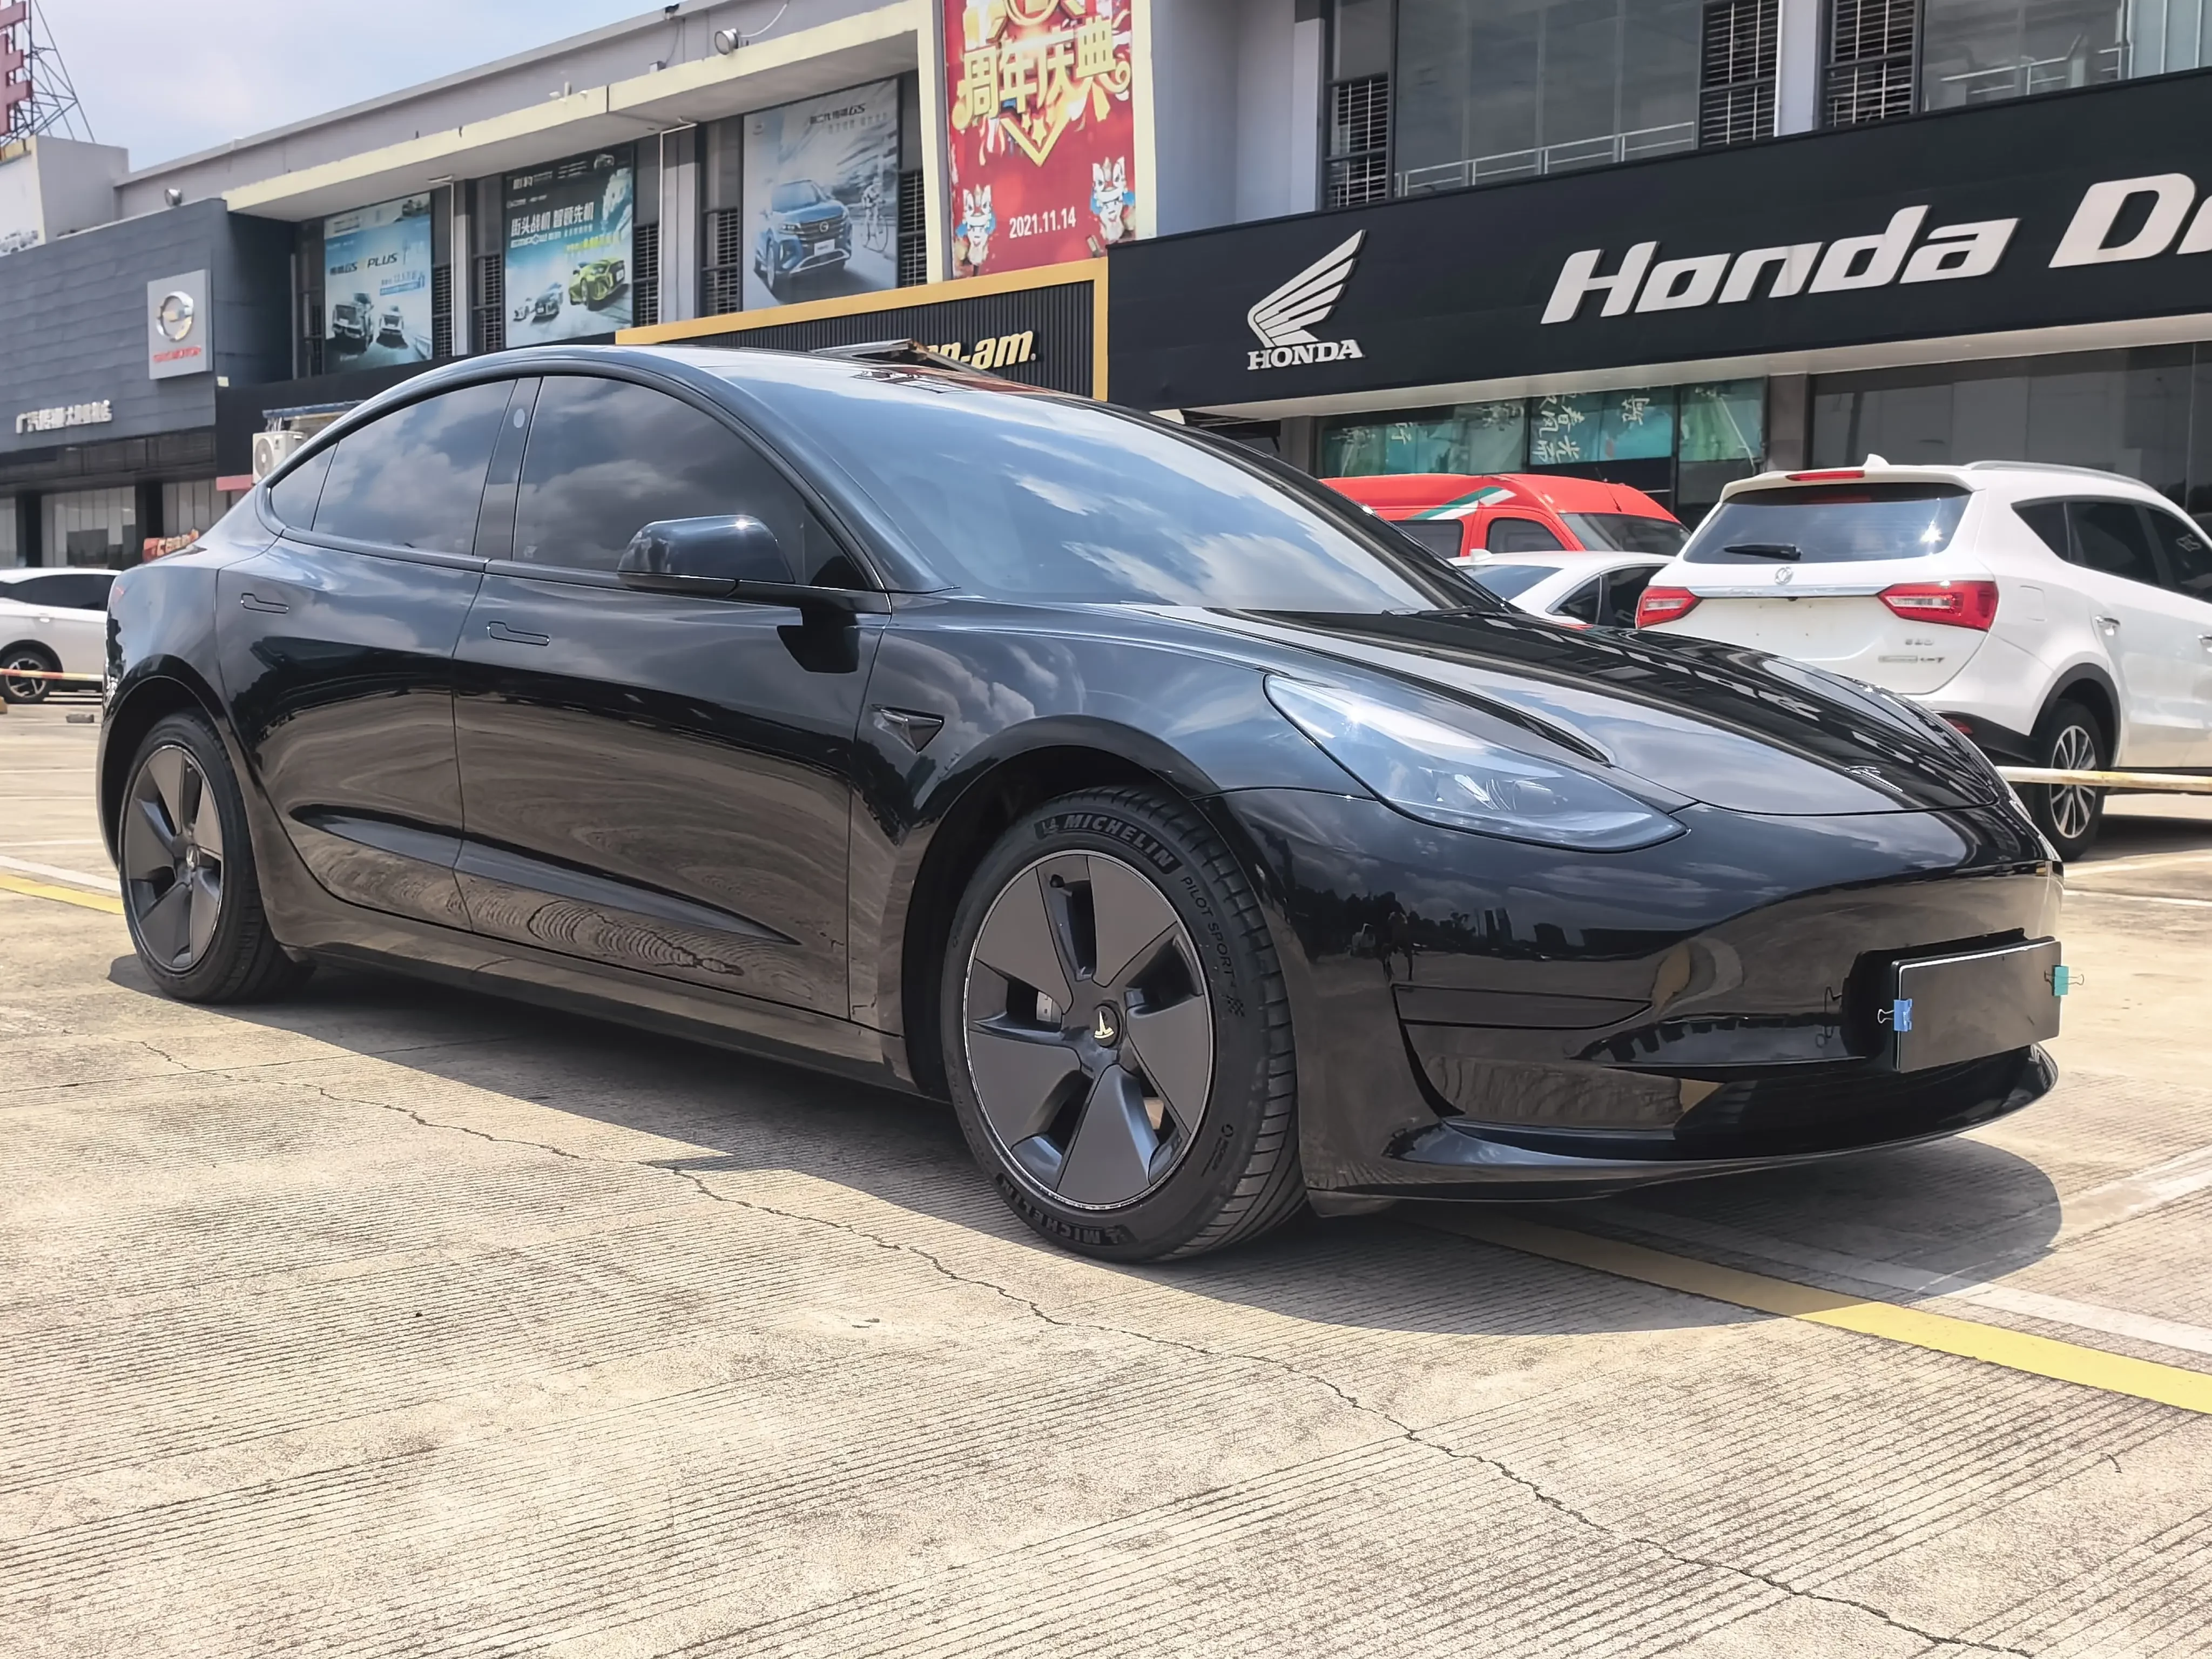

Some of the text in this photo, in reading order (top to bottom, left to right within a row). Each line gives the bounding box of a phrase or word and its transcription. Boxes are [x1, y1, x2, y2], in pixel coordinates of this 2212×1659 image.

[953, 15, 1130, 130] 周年庆典
[1009, 206, 1076, 239] 2021.11.14
[367, 253, 398, 268] PLUS
[1541, 205, 2020, 324] Honda
[1247, 339, 1363, 370] HONDA
[1064, 814, 1174, 867] MICHELIN
[1181, 876, 1214, 917] PILOT
[1208, 922, 1236, 979] SPORT
[1001, 1179, 1101, 1244] MICHELIN
